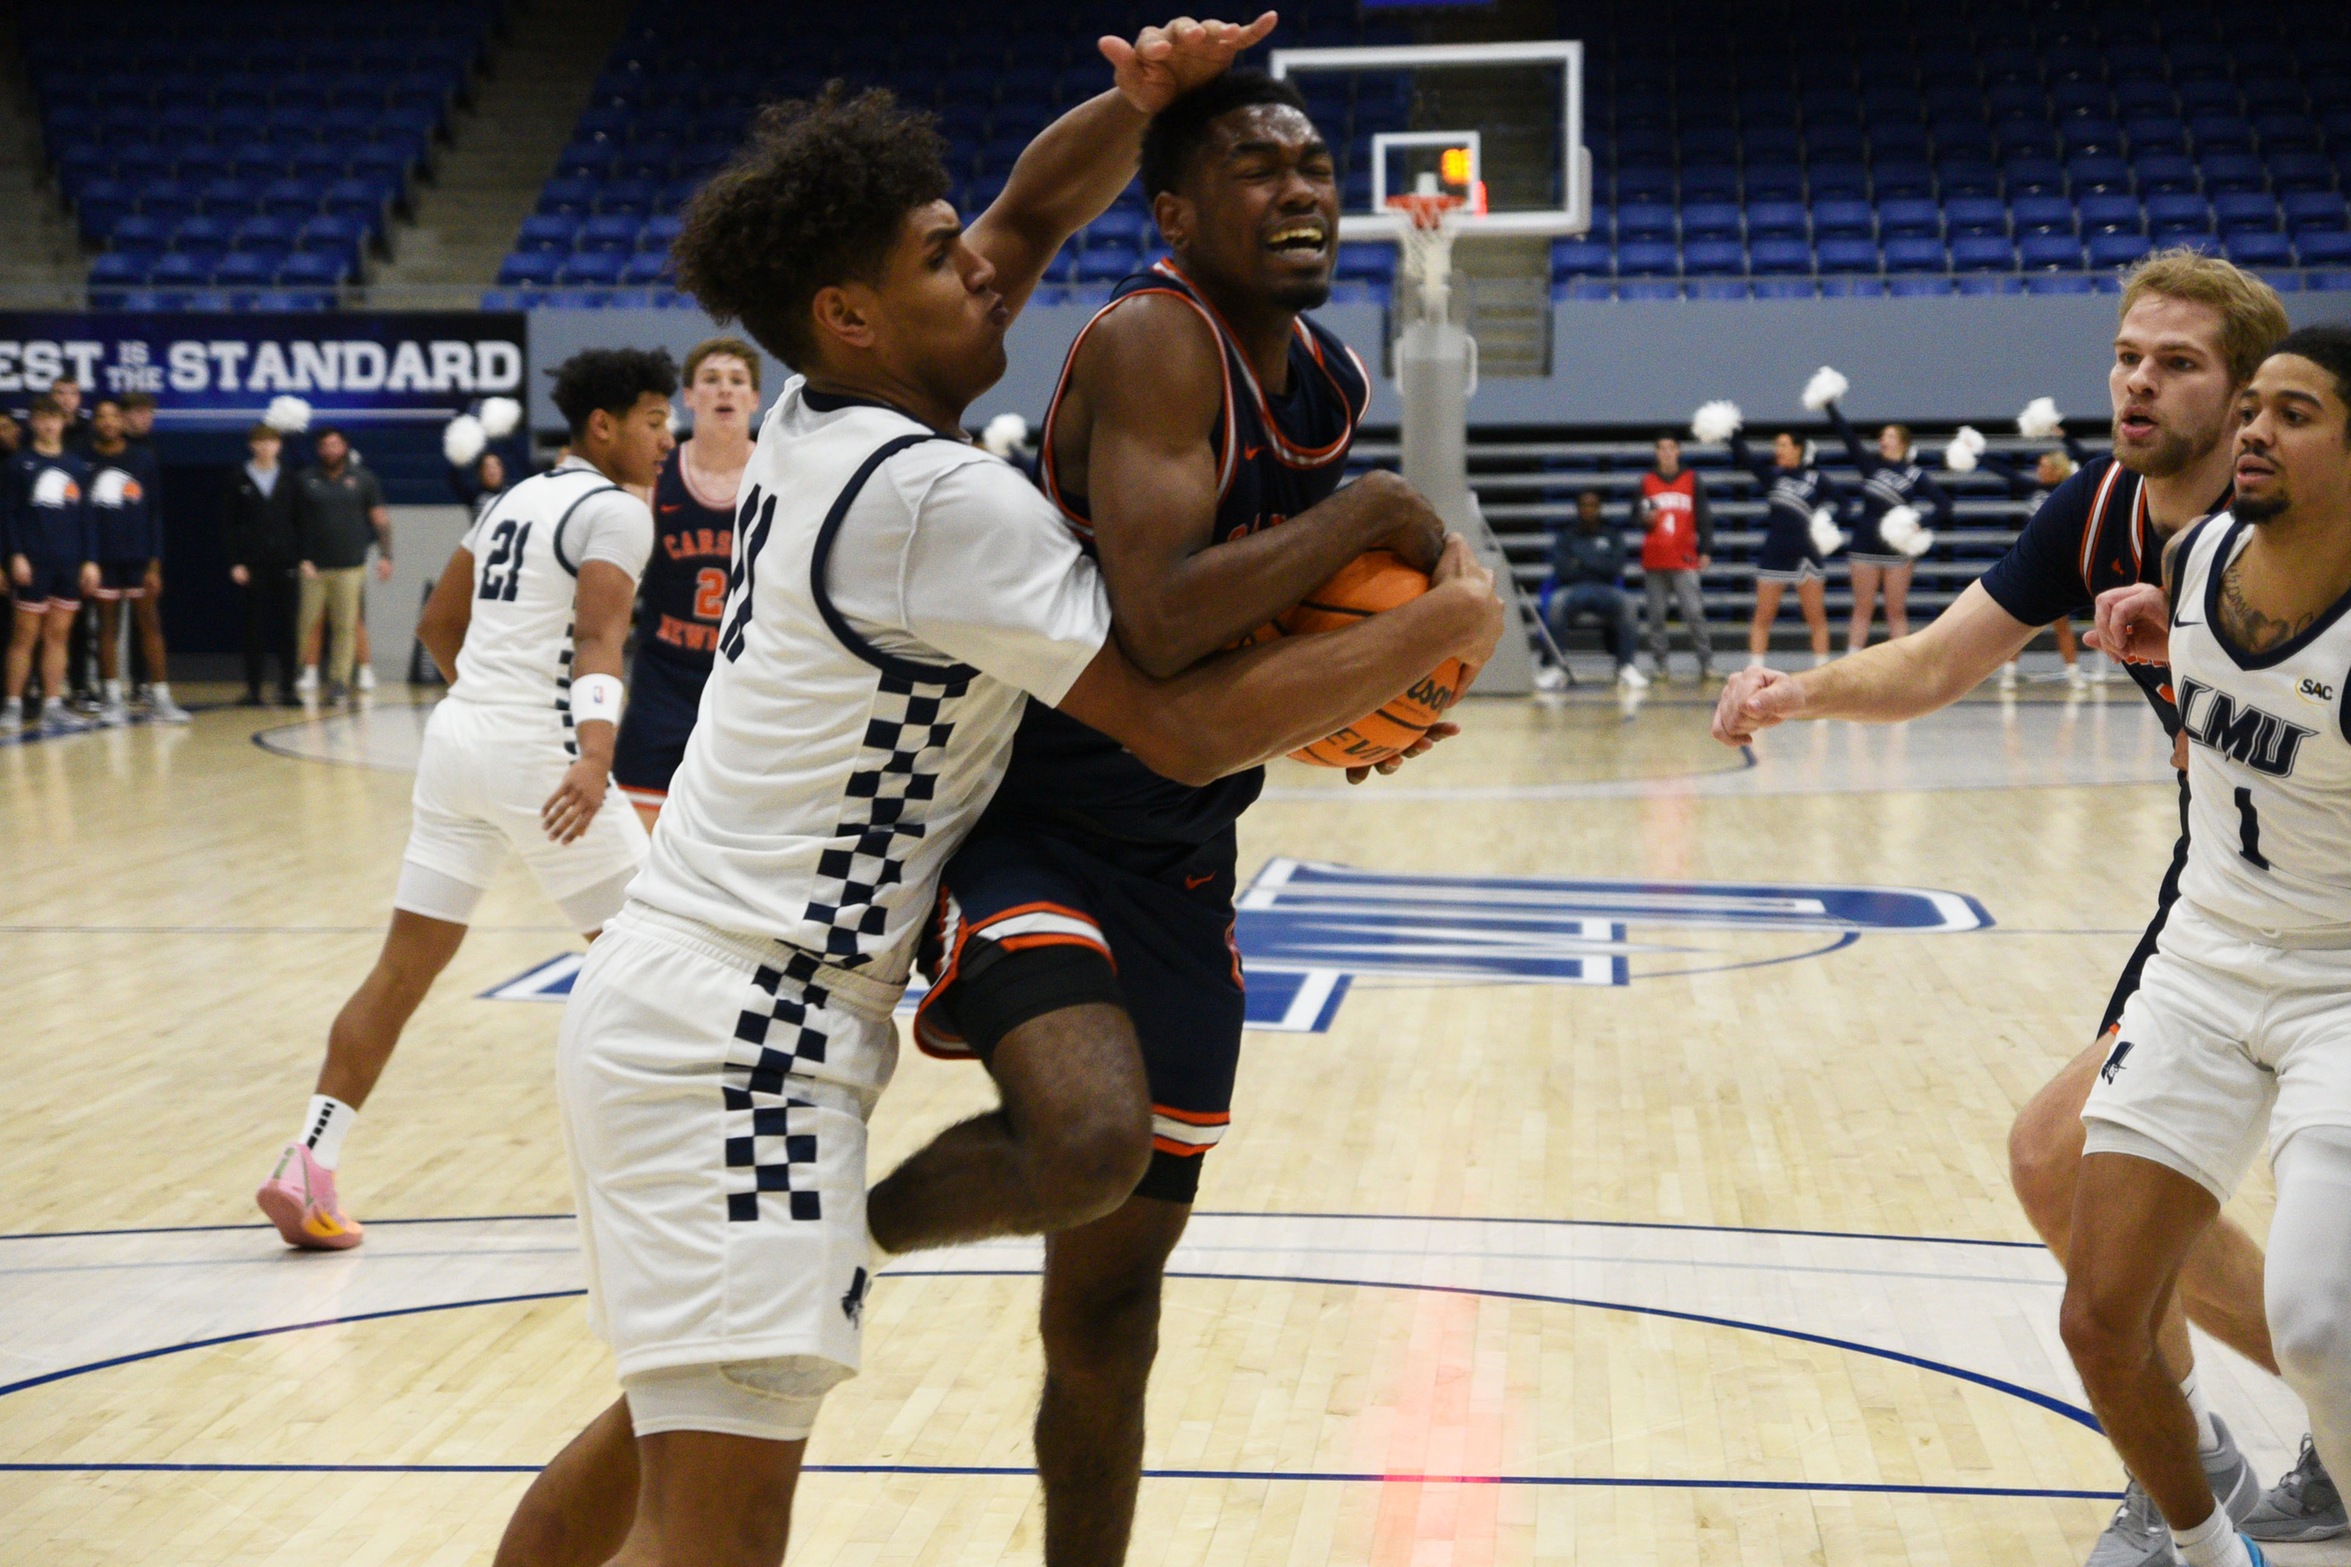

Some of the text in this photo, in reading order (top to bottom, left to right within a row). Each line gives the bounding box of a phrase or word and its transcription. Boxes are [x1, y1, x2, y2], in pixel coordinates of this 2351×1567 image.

[0, 340, 103, 392] EST
[118, 339, 150, 363] IS
[167, 340, 522, 392] STANDARD
[106, 365, 164, 393] THE
[478, 519, 532, 601] 21
[663, 528, 732, 561] CARS
[720, 484, 777, 664] 11
[656, 614, 719, 653] NEW
[2300, 678, 2333, 701] SAC
[2177, 675, 2320, 778] LMU
[2234, 787, 2270, 870] 1
